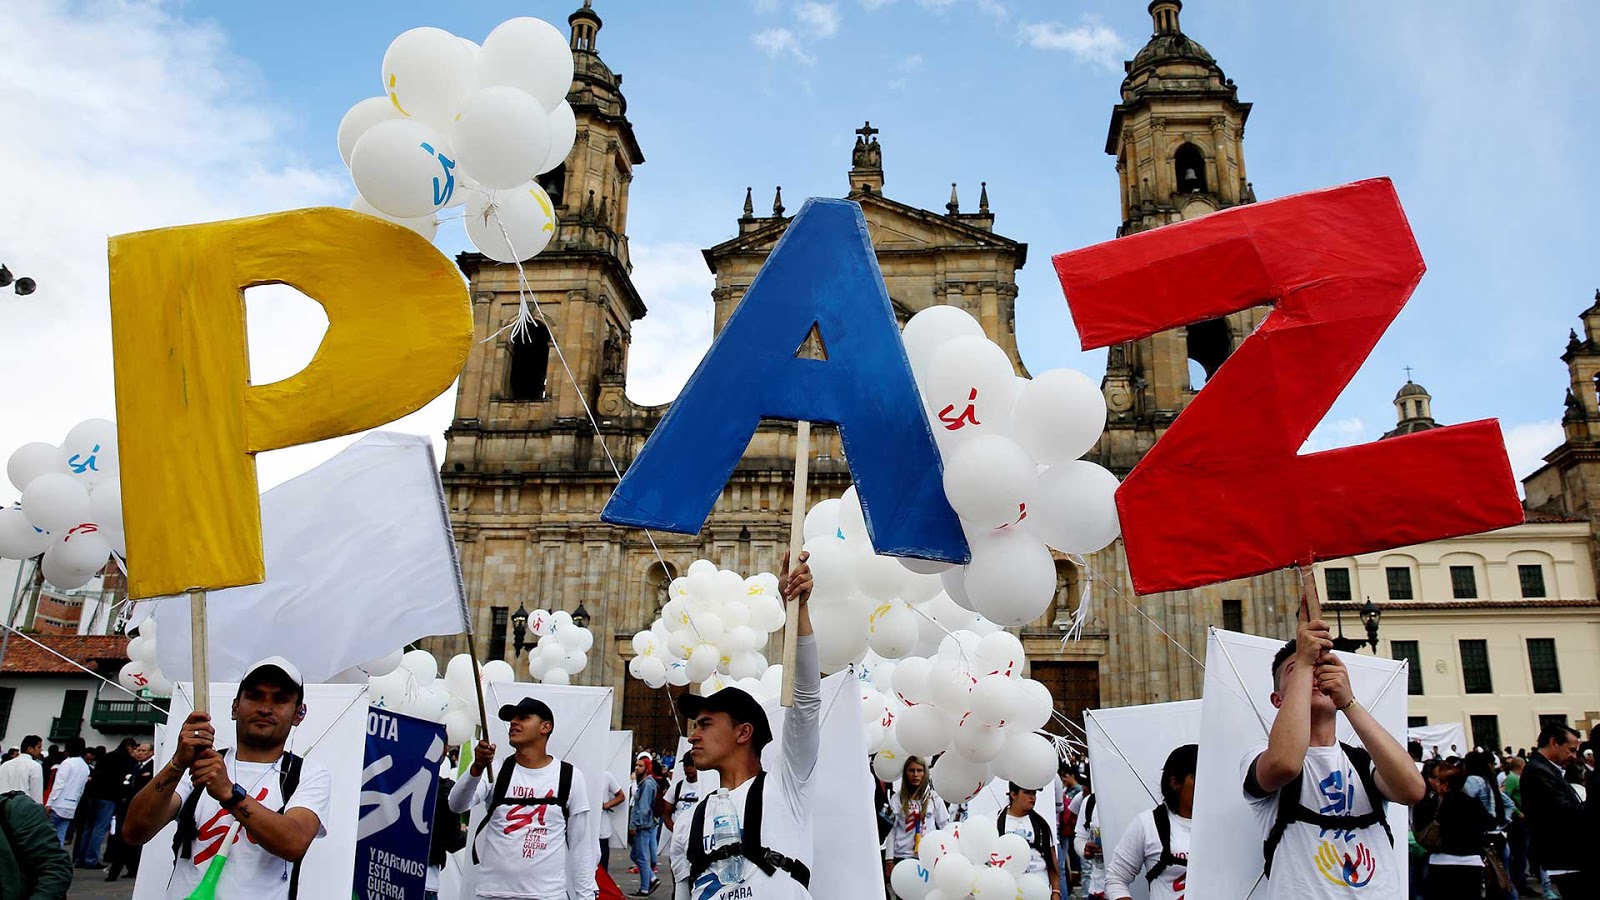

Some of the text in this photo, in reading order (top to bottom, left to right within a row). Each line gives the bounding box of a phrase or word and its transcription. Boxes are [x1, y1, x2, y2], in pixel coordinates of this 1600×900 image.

[367, 711, 399, 742] OTA
[512, 785, 534, 798] VOTA
[703, 834, 717, 851] TA
[368, 861, 391, 882] ESTA
[369, 846, 425, 878] Y PAREMOS
[367, 875, 405, 900] GUERRA
[728, 886, 753, 900] PARA
